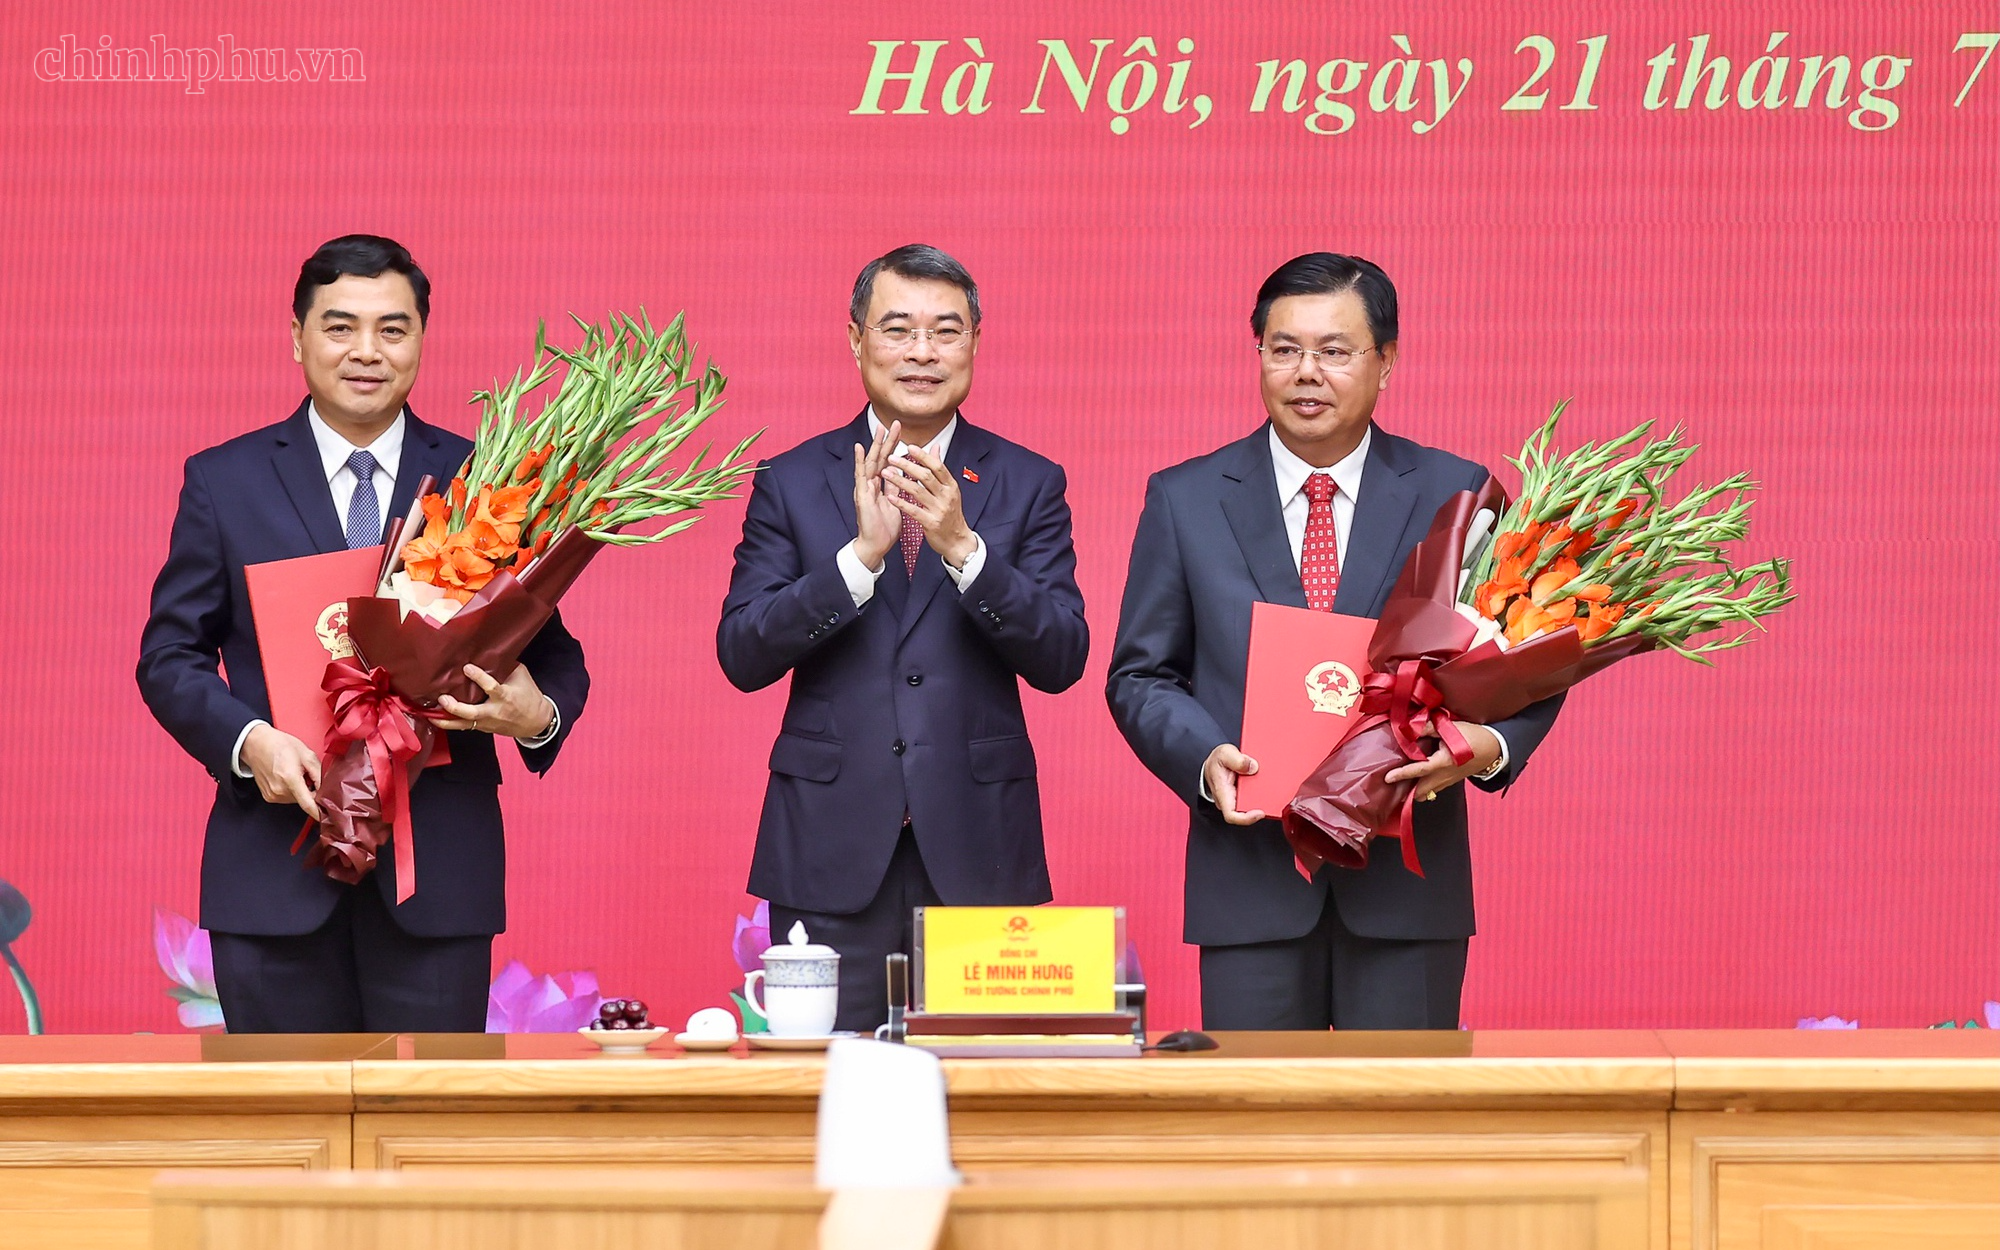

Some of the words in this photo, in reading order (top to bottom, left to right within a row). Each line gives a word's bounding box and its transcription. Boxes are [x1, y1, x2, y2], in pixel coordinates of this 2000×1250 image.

[849, 38, 994, 115] Hà
[1020, 37, 1213, 135] Nội,
[1250, 35, 1473, 135] ngày
[1501, 35, 1608, 110] 21
[1643, 32, 1912, 131] tháng
[1951, 33, 2000, 107] 7
[964, 962, 980, 980] LÊ
[986, 965, 1026, 980] MINH
[1032, 964, 1073, 980] HƯNG
